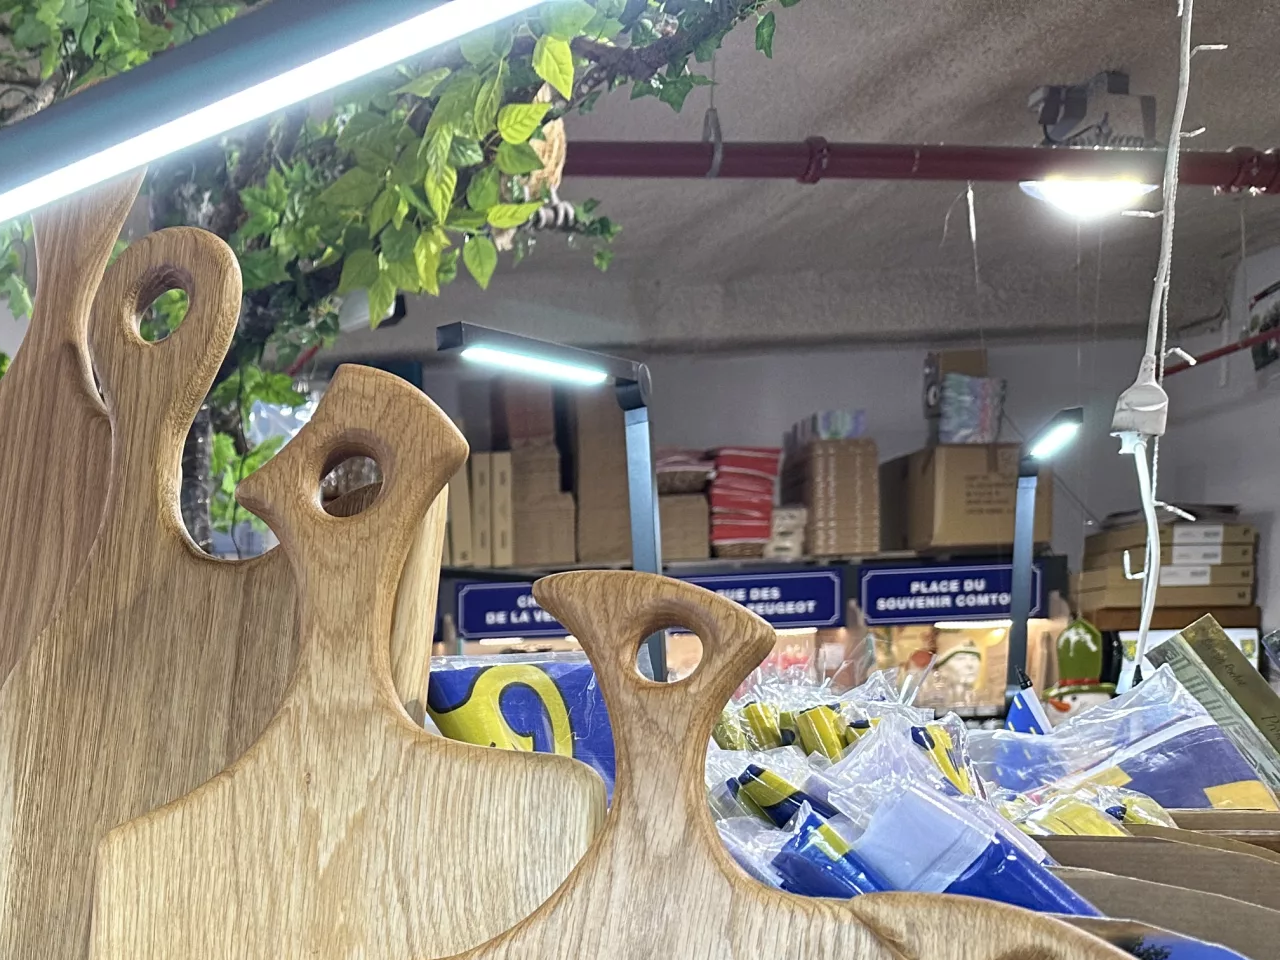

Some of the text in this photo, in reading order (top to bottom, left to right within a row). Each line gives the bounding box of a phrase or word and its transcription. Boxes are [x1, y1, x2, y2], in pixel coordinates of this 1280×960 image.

[750, 587, 780, 601] DES
[910, 578, 986, 594] PLACE DU
[876, 592, 1011, 610] SOUVENIR COMTO
[485, 610, 507, 625] DE
[510, 609, 530, 624] LA
